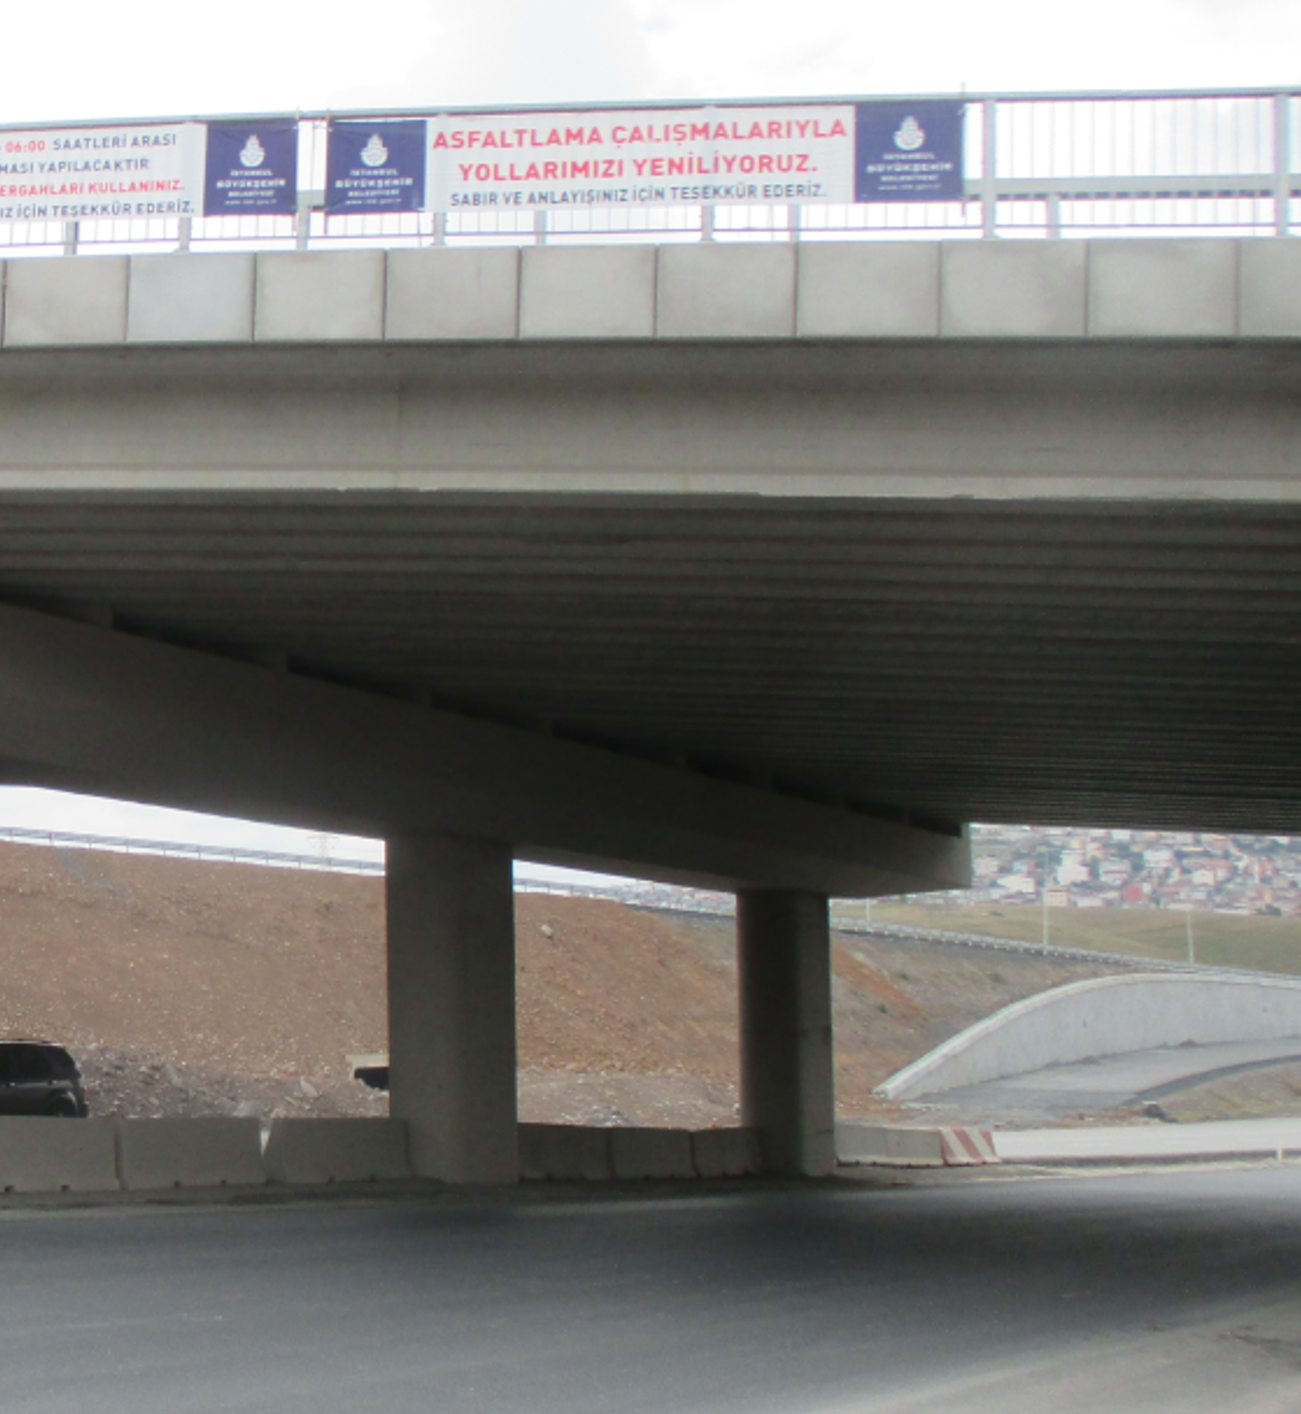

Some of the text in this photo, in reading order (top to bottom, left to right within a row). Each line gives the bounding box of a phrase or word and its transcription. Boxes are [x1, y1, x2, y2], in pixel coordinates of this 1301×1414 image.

[5, 139, 46, 153] 06:00
[52, 133, 127, 150] SAATLERİ
[130, 132, 177, 148] ARASI
[432, 118, 847, 149] ASFALTLAMA ÇALIŞMALARIYLA
[38, 157, 150, 174] YAPILACAKTIR
[459, 149, 818, 181] YOLLARIMIZI YENİLİYORUZ.
[88, 178, 185, 194] KULLANINIZ.
[450, 191, 499, 206] SABIR
[503, 190, 522, 204] VE
[526, 187, 629, 206] ANLAYIŞINIZ
[632, 184, 665, 203] İÇİN
[17, 202, 49, 219] İÇİN
[51, 199, 132, 218] TEŞEKKÜR
[135, 197, 195, 214] EDERİZ.
